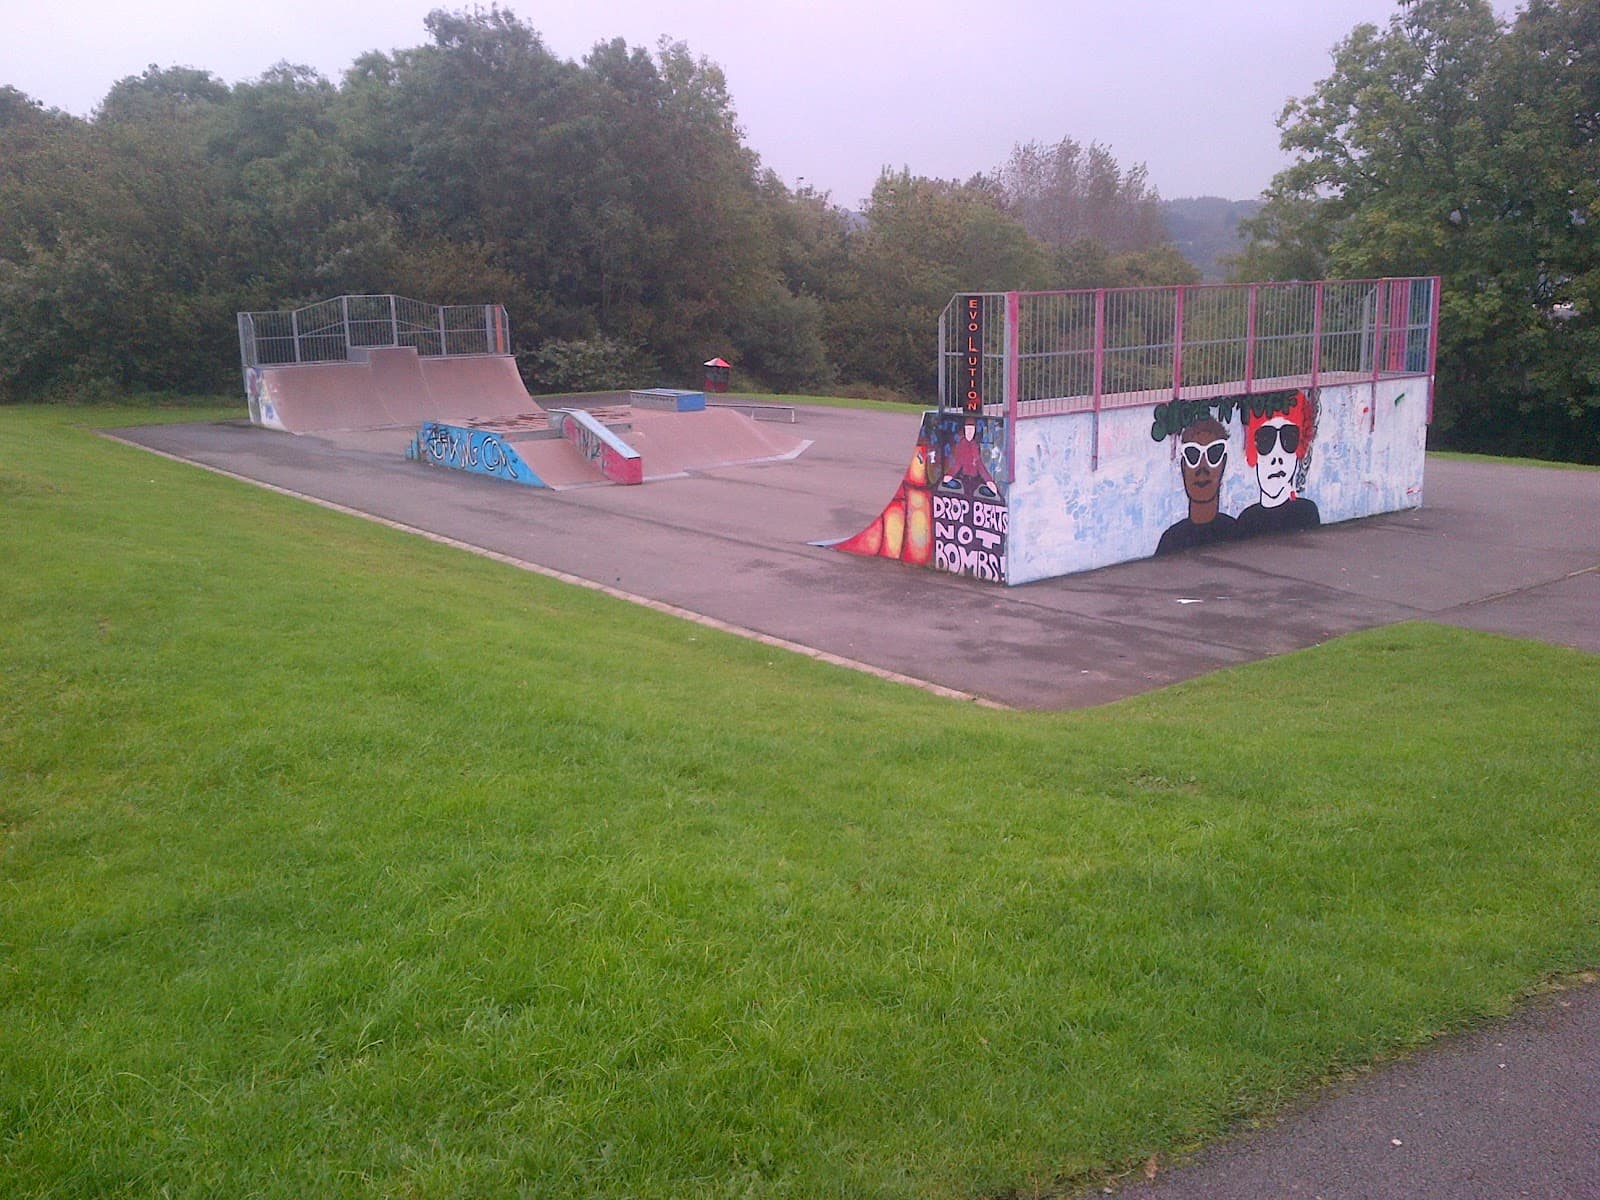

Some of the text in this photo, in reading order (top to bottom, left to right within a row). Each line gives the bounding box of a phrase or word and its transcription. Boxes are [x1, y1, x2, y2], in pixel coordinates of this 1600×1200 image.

[967, 299, 979, 411] EVOLUTION
[933, 496, 1008, 534] DROP BEATS
[935, 521, 1001, 549] NOT
